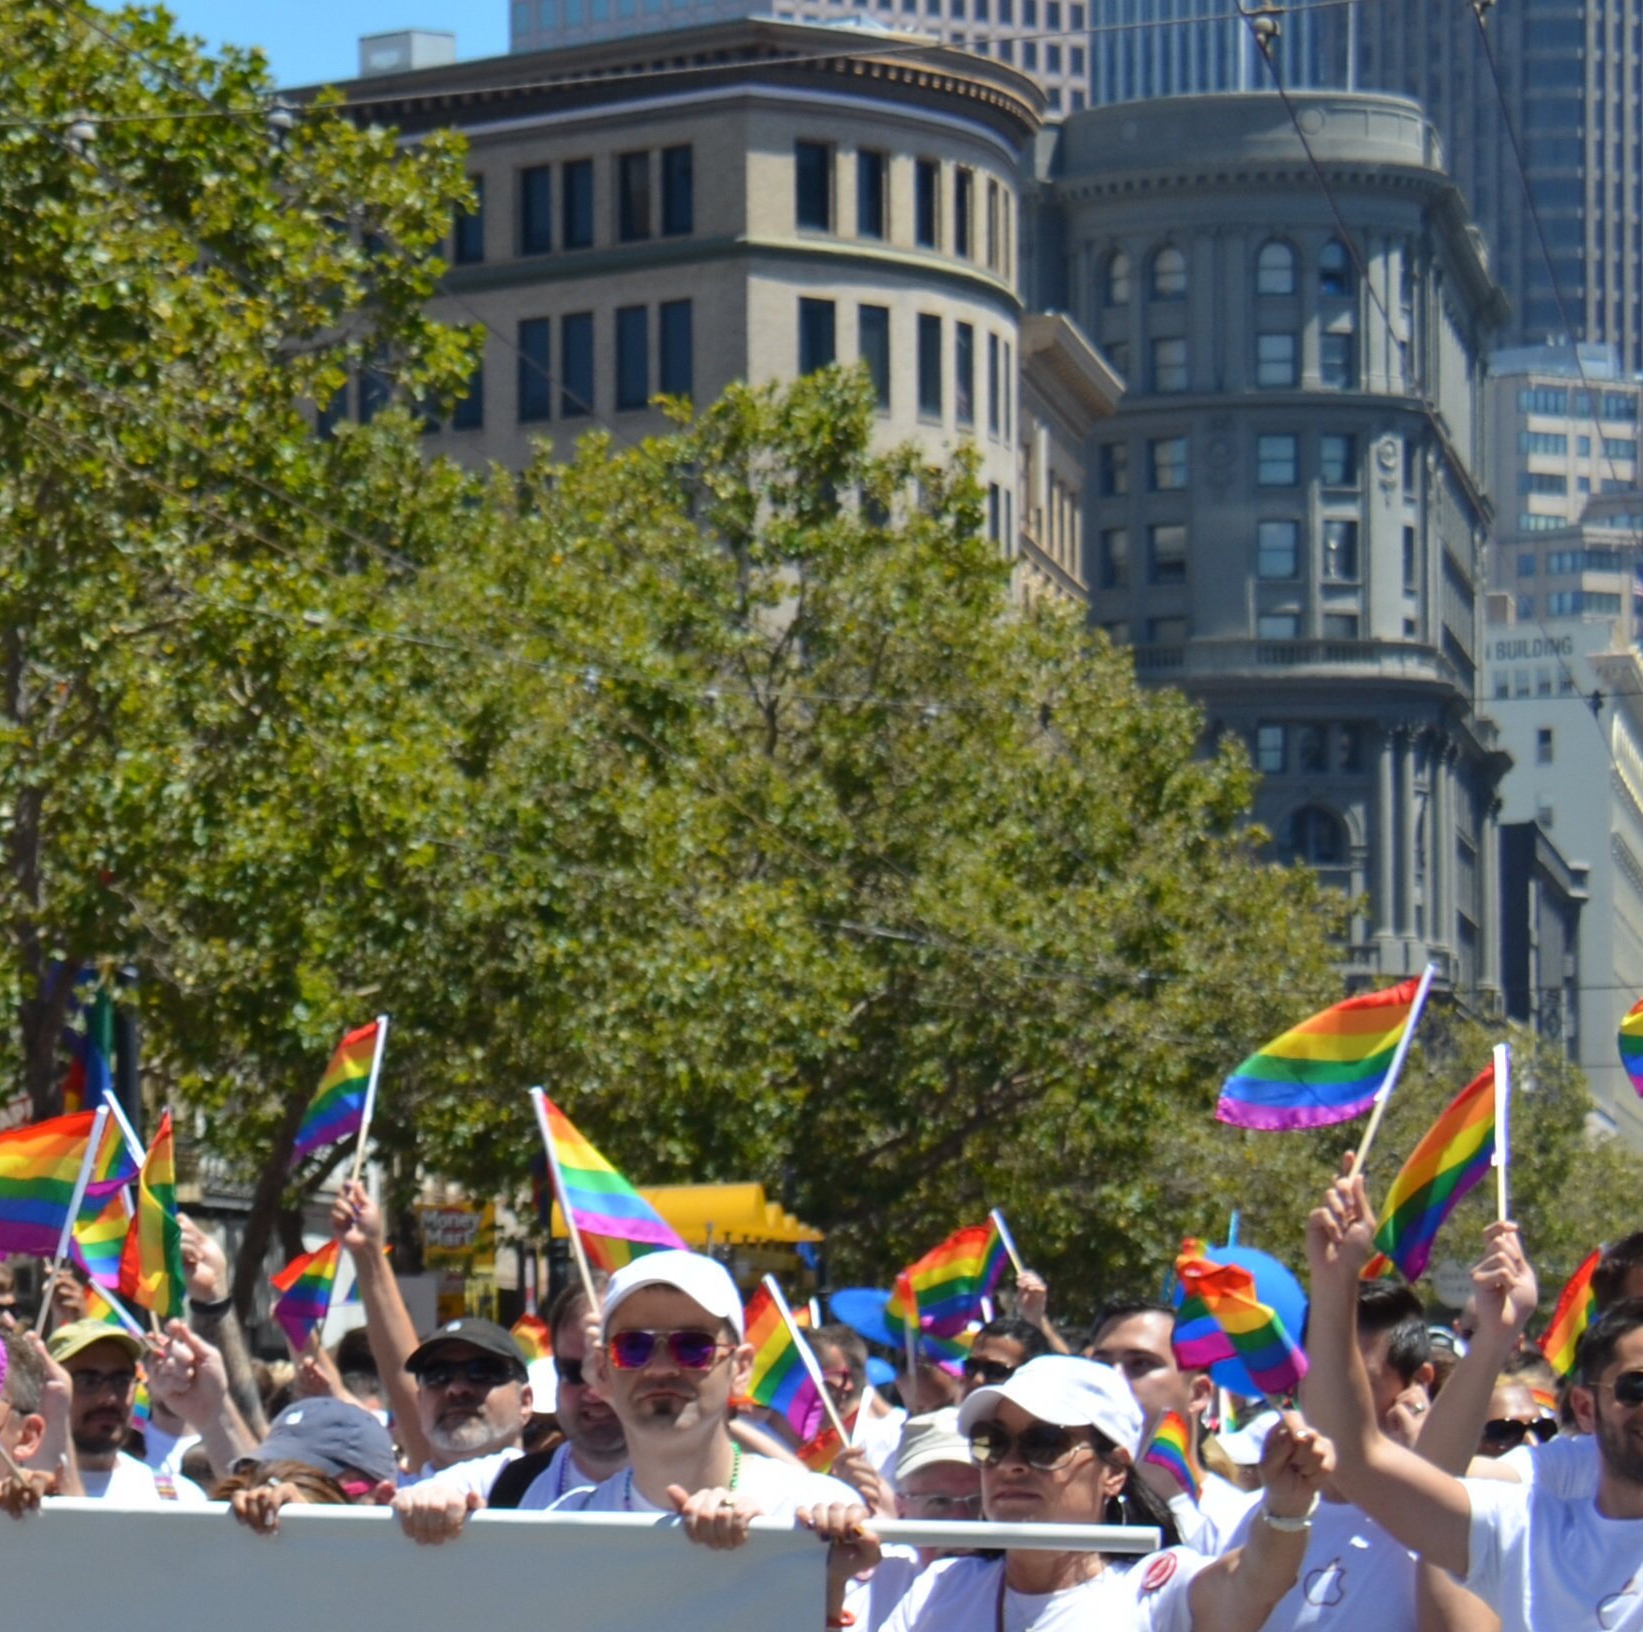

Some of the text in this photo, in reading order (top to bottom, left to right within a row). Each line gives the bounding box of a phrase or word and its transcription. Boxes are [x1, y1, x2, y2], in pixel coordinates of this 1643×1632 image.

[1495, 635, 1574, 661] BUILDING
[421, 1209, 483, 1231] Money
[426, 1230, 476, 1249] Mart
